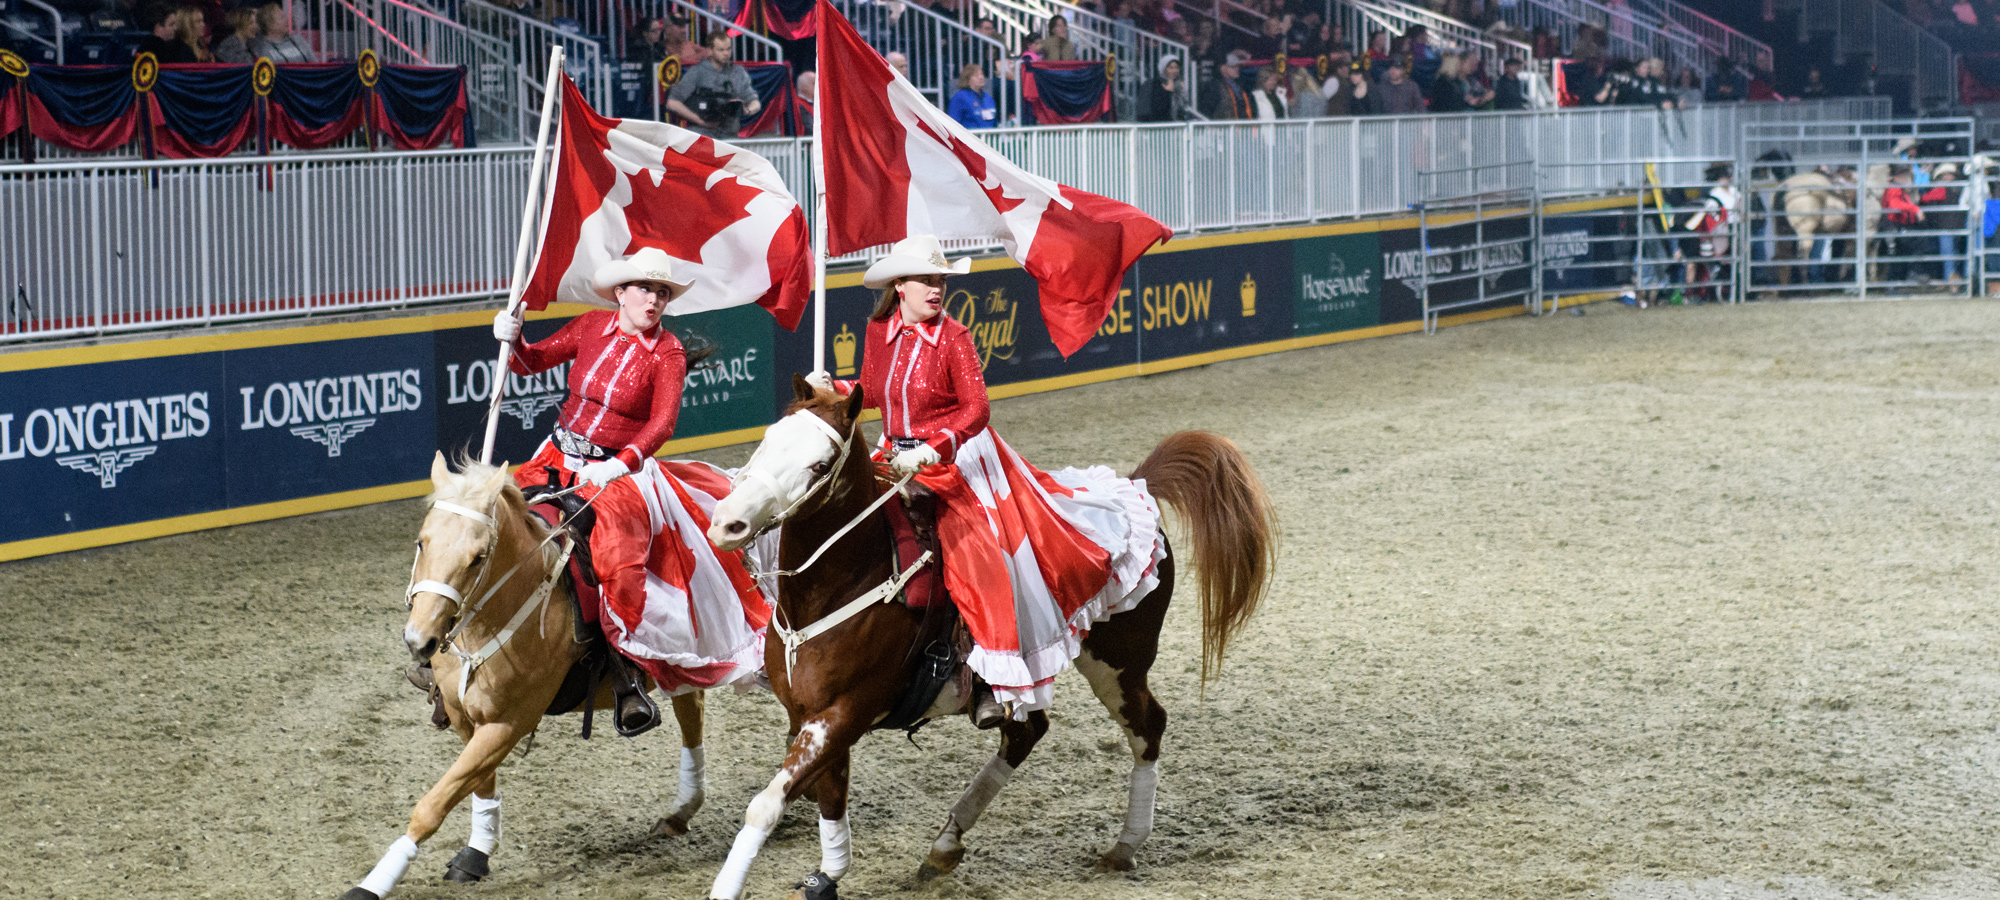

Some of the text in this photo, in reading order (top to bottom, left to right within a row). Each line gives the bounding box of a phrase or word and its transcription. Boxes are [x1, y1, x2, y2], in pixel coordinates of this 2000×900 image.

[985, 287, 1007, 314] The
[1143, 279, 1212, 331] SHOW
[240, 369, 422, 430] LONGINES
[682, 392, 729, 408] ELAND
[0, 391, 210, 461] LONGINES
